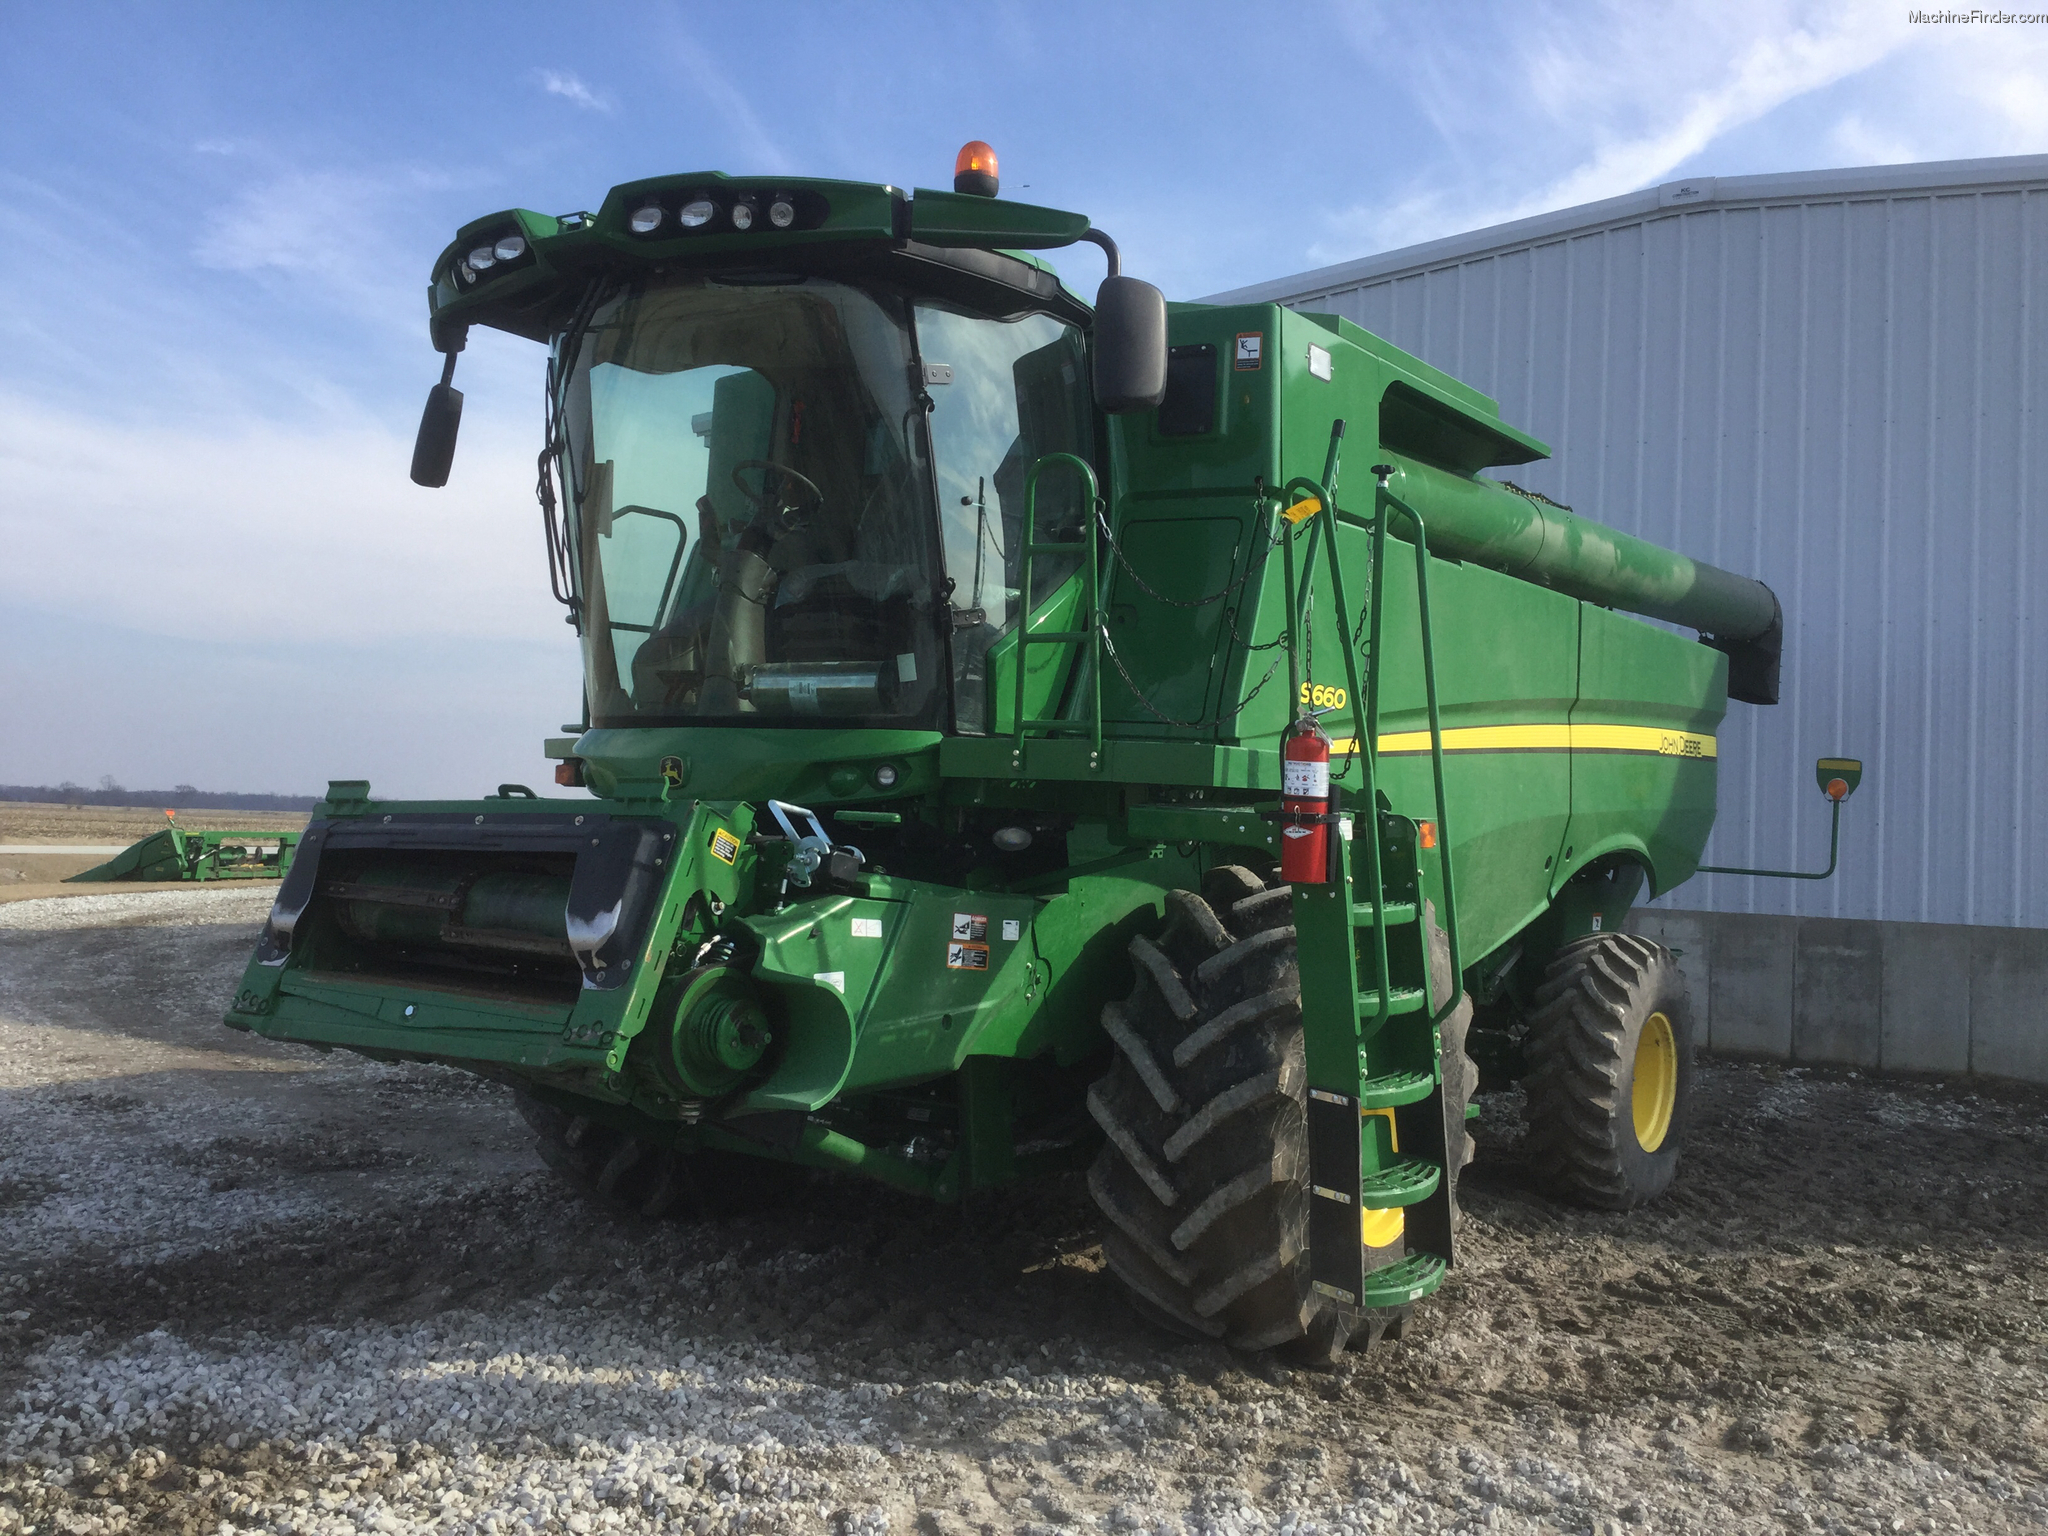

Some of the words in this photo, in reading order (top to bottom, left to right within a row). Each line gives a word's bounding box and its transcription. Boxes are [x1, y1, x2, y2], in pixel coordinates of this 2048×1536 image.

[1300, 681, 1346, 710] S660
[1659, 733, 1680, 755] JOHN
[1680, 735, 1702, 757] DEERE
